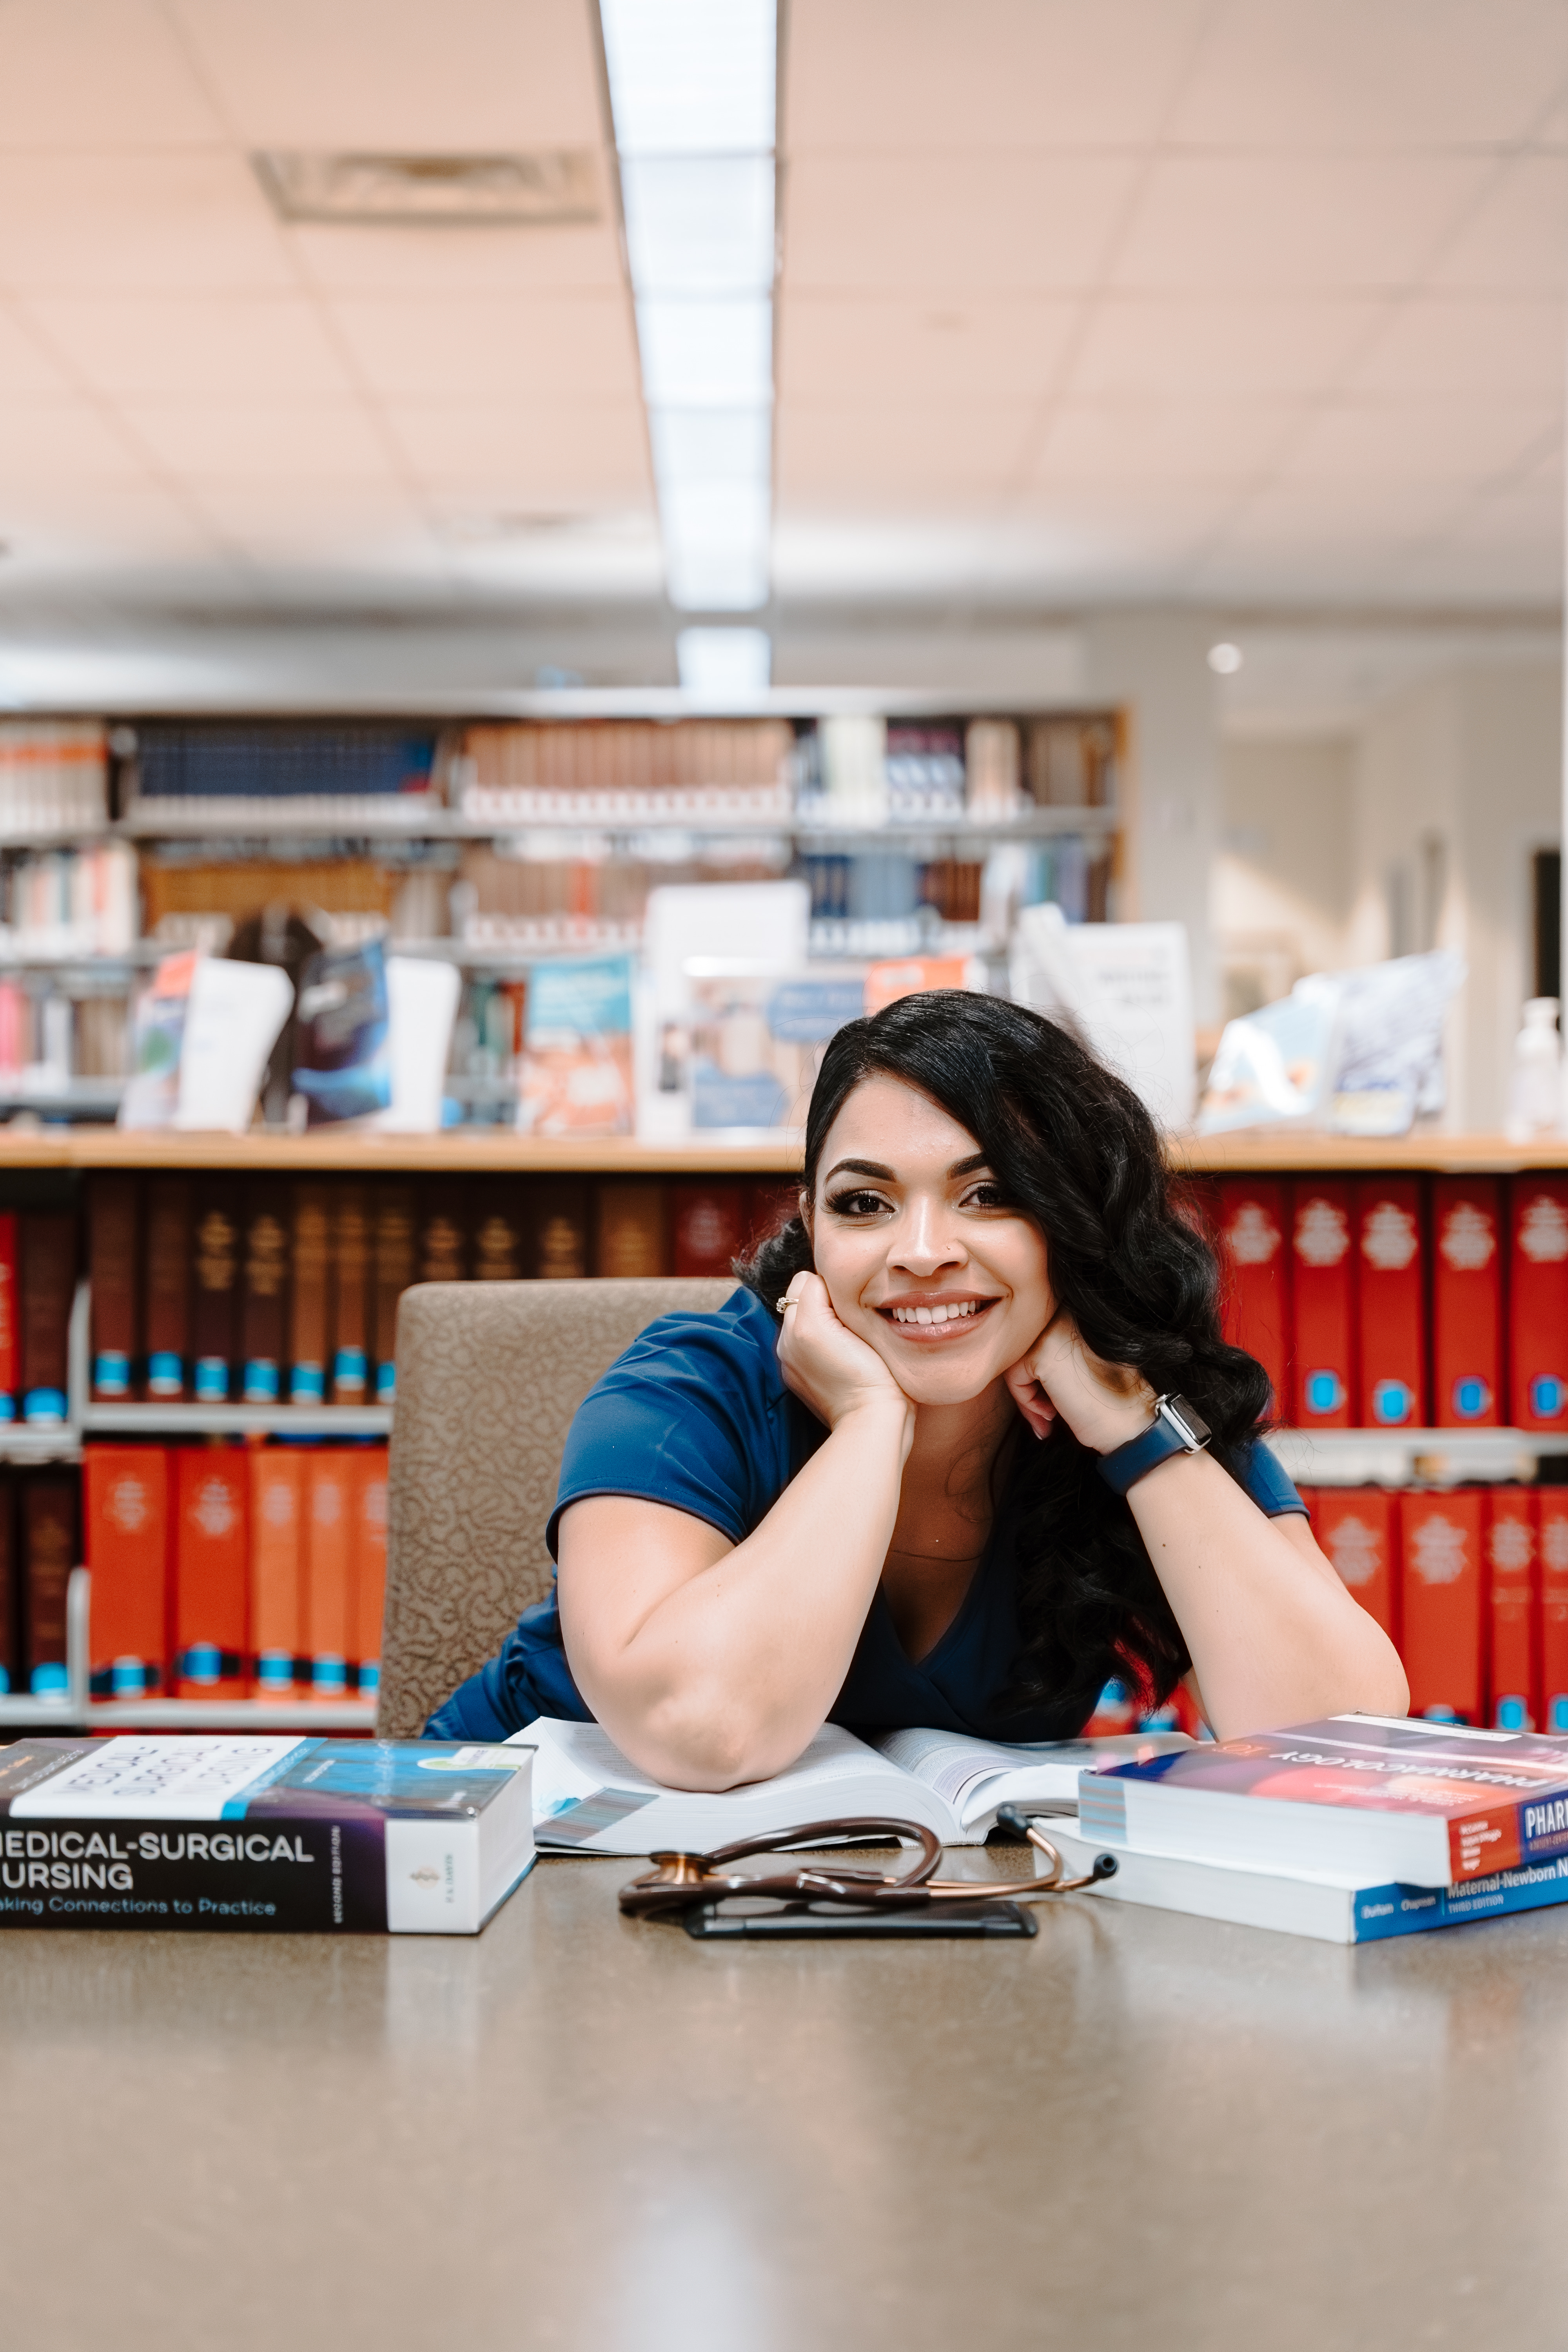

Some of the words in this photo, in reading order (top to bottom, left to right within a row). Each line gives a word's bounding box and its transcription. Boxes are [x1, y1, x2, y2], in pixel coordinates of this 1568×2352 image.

[113, 1745, 222, 1796] SURGICAL
[1269, 1750, 1548, 1787] PHARMACOLOGY
[0, 1830, 314, 1862] EDICAL-SURGICAL
[1447, 1866, 1556, 1899] Maternal-Newborn
[49, 1895, 168, 1915] Connections
[173, 1900, 193, 1914] to
[198, 1896, 277, 1916] Practice
[1448, 1899, 1472, 1914] THIRD
[1472, 1894, 1504, 1911] EDITION
